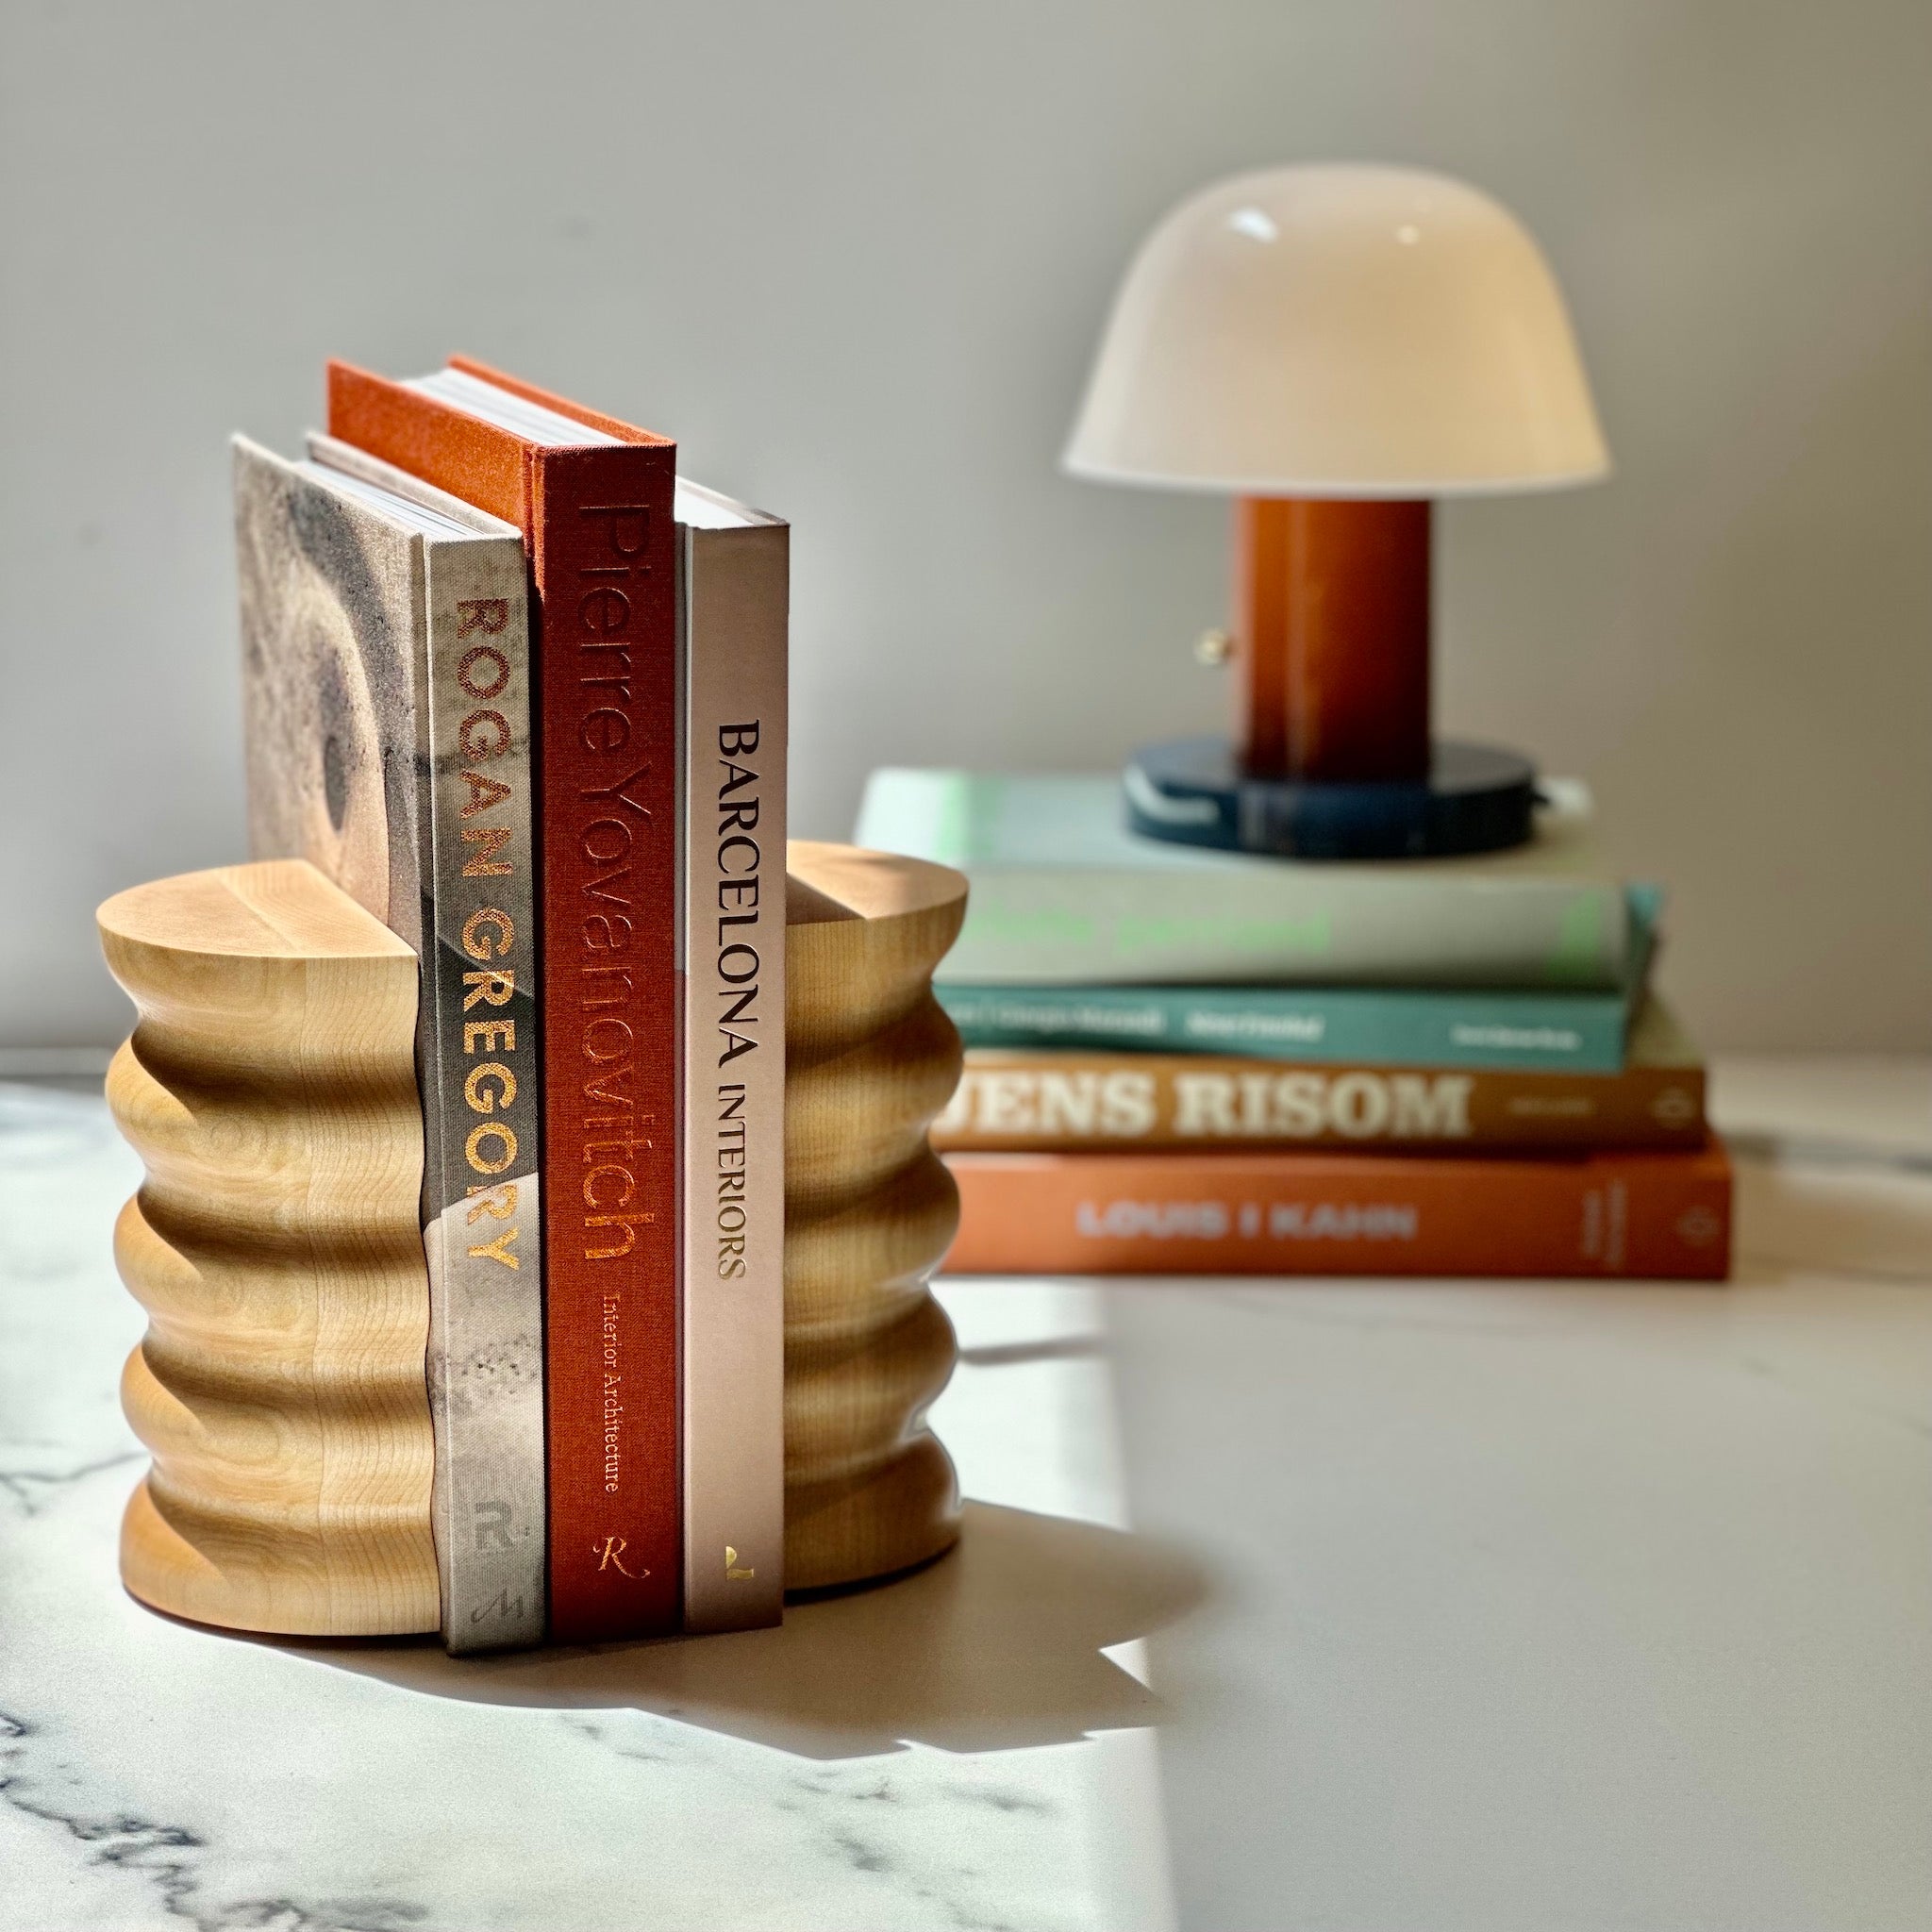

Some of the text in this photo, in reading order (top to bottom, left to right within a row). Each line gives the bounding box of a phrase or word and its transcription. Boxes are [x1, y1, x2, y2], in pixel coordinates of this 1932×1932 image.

[455, 597, 520, 1271] ROGAN GREGORY
[577, 504, 655, 1261] Pierre Yovanovitch
[716, 719, 760, 1282] BARCELONA INTERIORS
[934, 1068, 1474, 1141] JENS RISOM
[1074, 1198, 1229, 1241] LOUIS
[1268, 1203, 1418, 1242] KAHN
[603, 1294, 625, 1494] Interior Architecture
